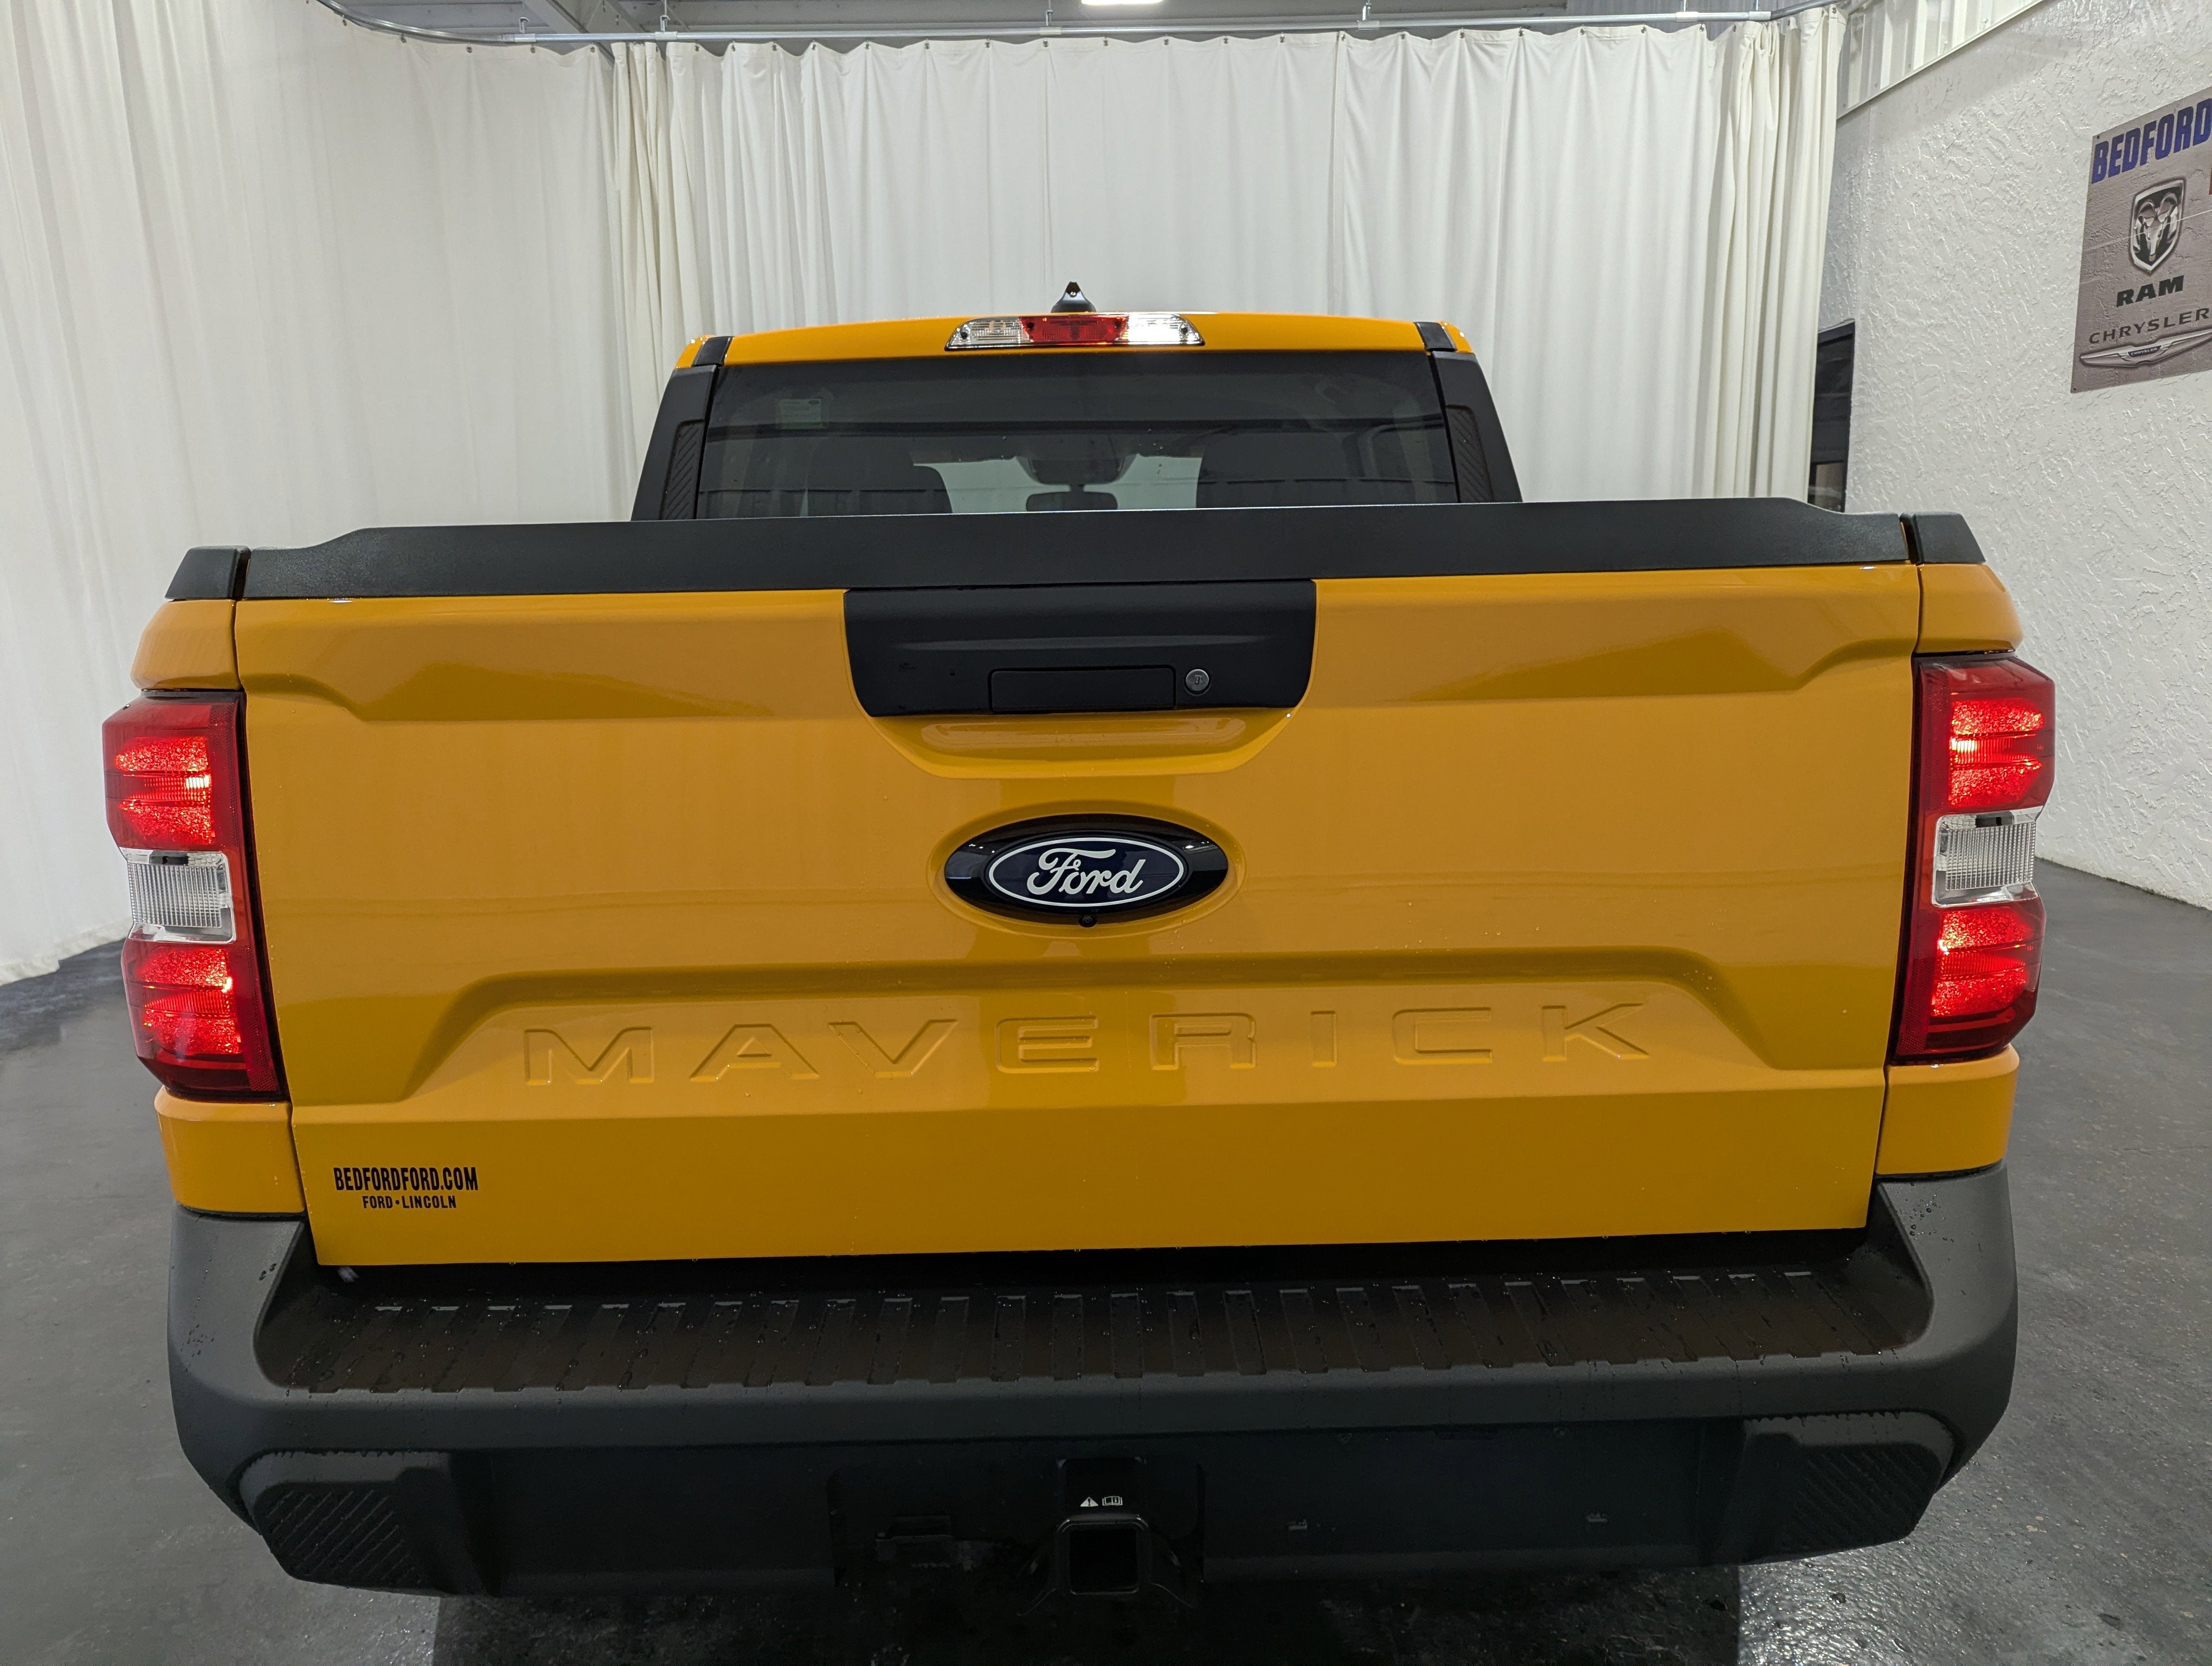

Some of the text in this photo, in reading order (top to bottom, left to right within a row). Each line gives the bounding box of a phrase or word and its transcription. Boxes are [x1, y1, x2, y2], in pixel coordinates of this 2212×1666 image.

[2091, 98, 2212, 184] BEDFORD
[2116, 275, 2184, 307] RAM
[2089, 307, 2209, 344] CHRYSLER
[1027, 848, 1146, 895] Ford
[524, 1003, 1650, 1086] MAVERICK
[333, 1167, 479, 1191] BEDFORDFORD.COM
